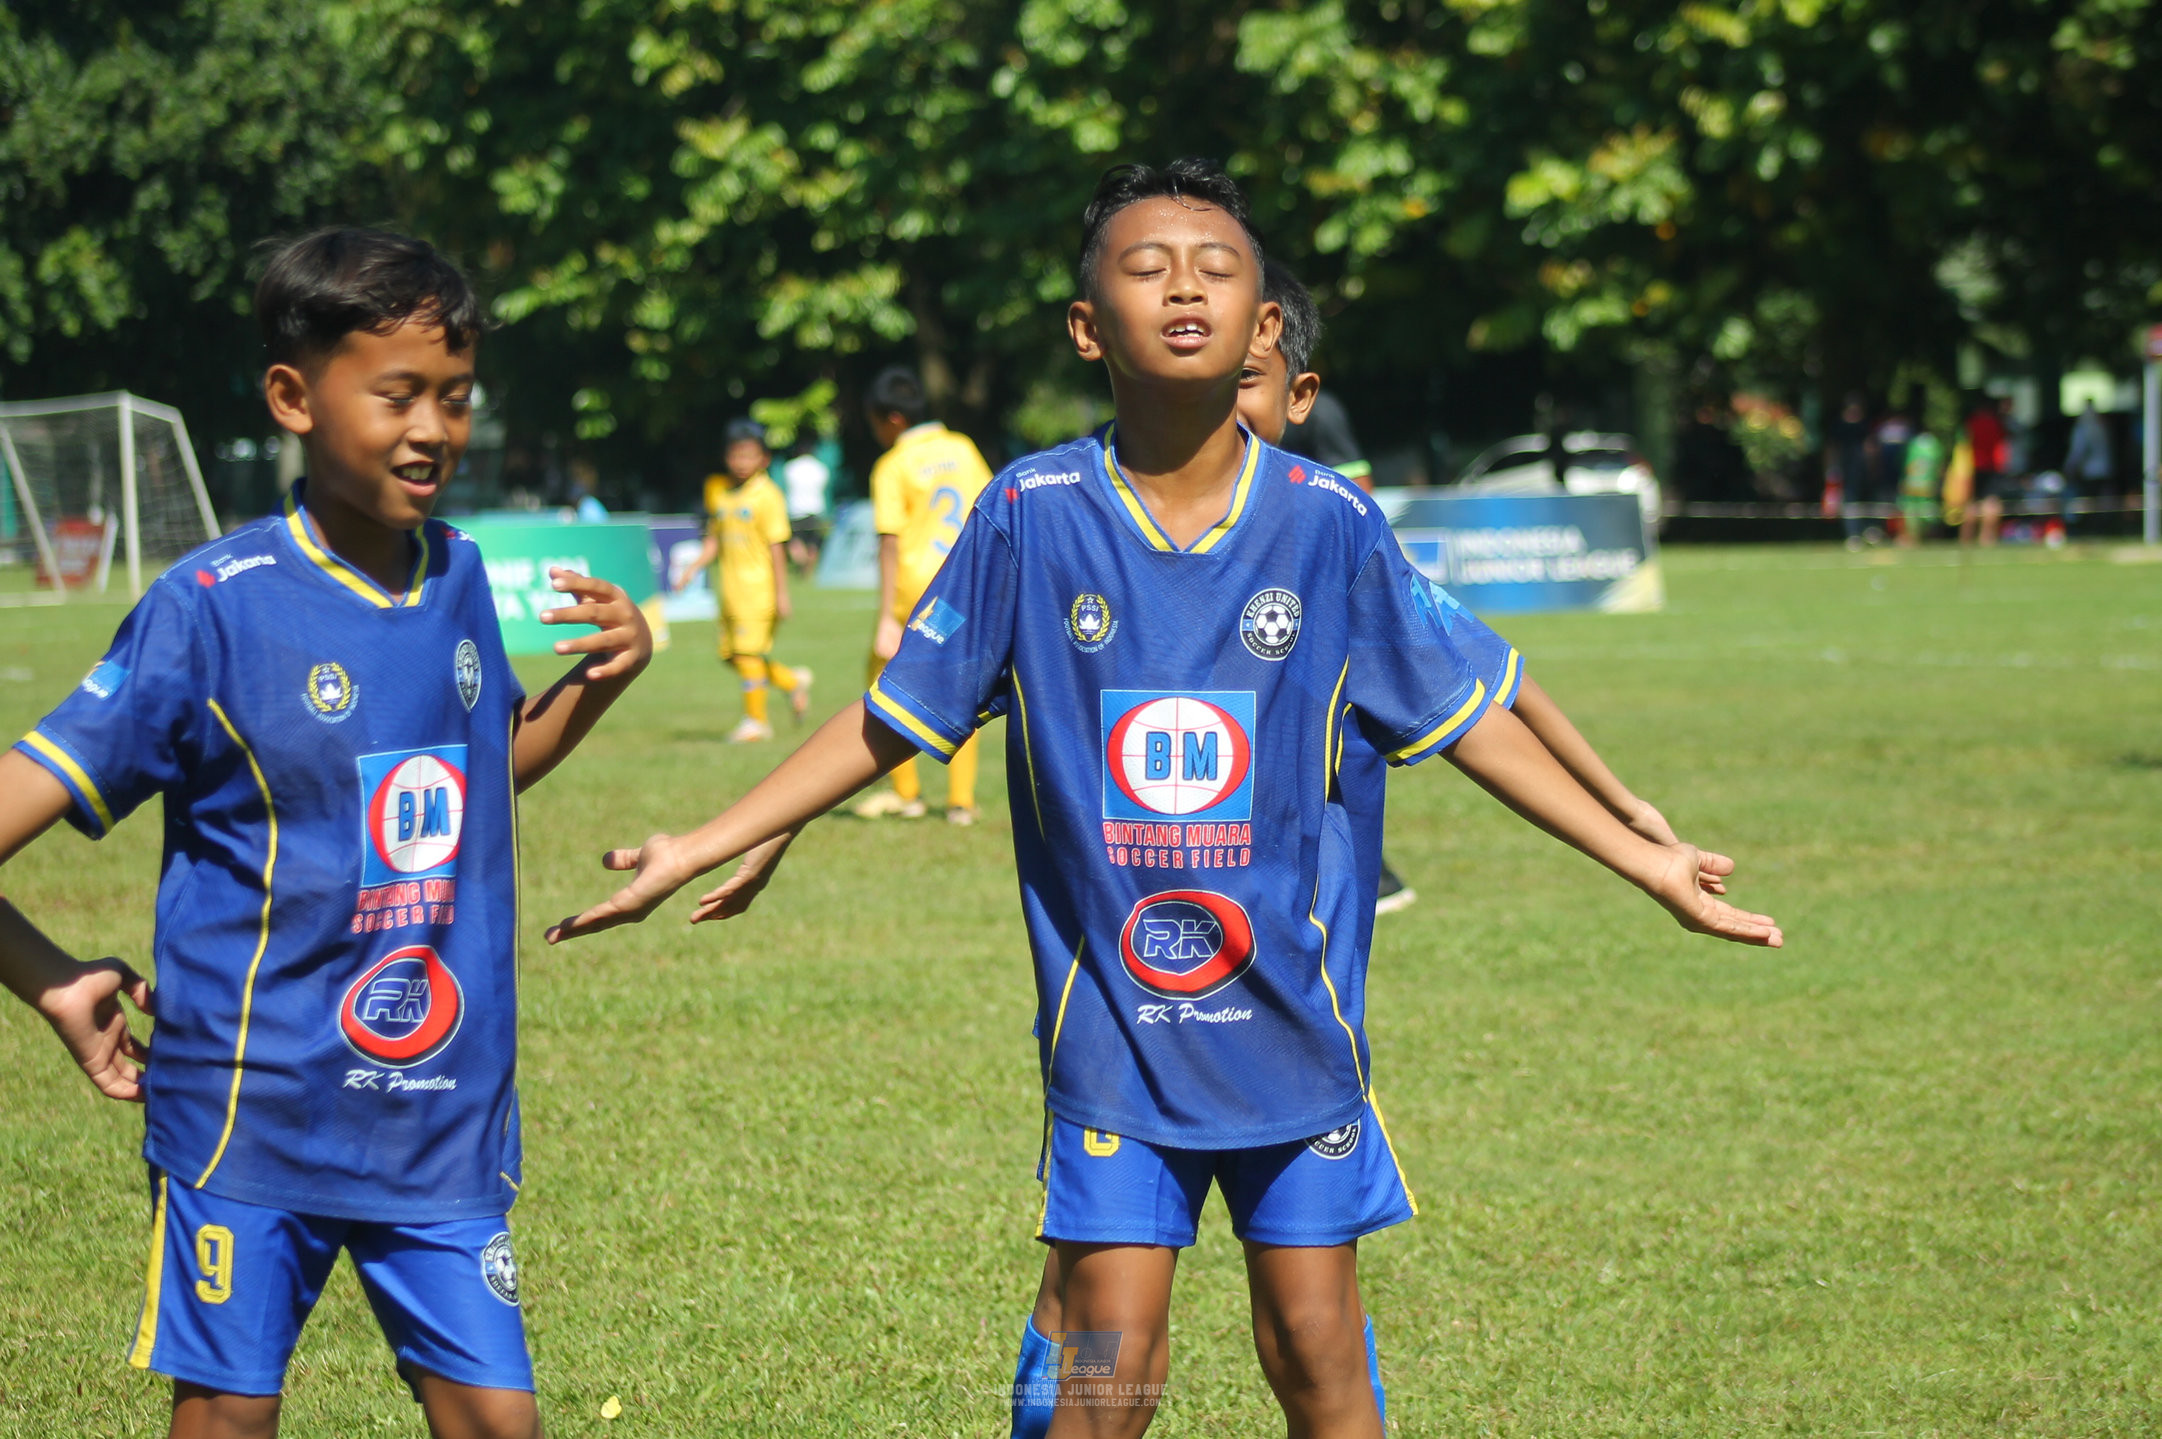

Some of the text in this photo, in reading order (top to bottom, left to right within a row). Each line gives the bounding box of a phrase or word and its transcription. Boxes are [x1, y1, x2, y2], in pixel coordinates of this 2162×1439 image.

[1019, 472, 1080, 492] Jakarta
[1308, 475, 1367, 517] Jakarta
[930, 486, 964, 556] 3
[1081, 604, 1099, 612] PSSI
[1275, 592, 1300, 617] UNITED
[1247, 632, 1272, 656] SOCCER
[1145, 731, 1218, 781] BM
[397, 786, 452, 842] BM
[1102, 821, 1252, 848] BINTANG MUARA
[1191, 848, 1252, 869] FIELD
[1142, 918, 1218, 960] RK
[363, 977, 429, 1023] RK
[1136, 1002, 1253, 1025] RK Promotion
[342, 1068, 458, 1093] RK Promotion
[194, 1223, 235, 1305] 9
